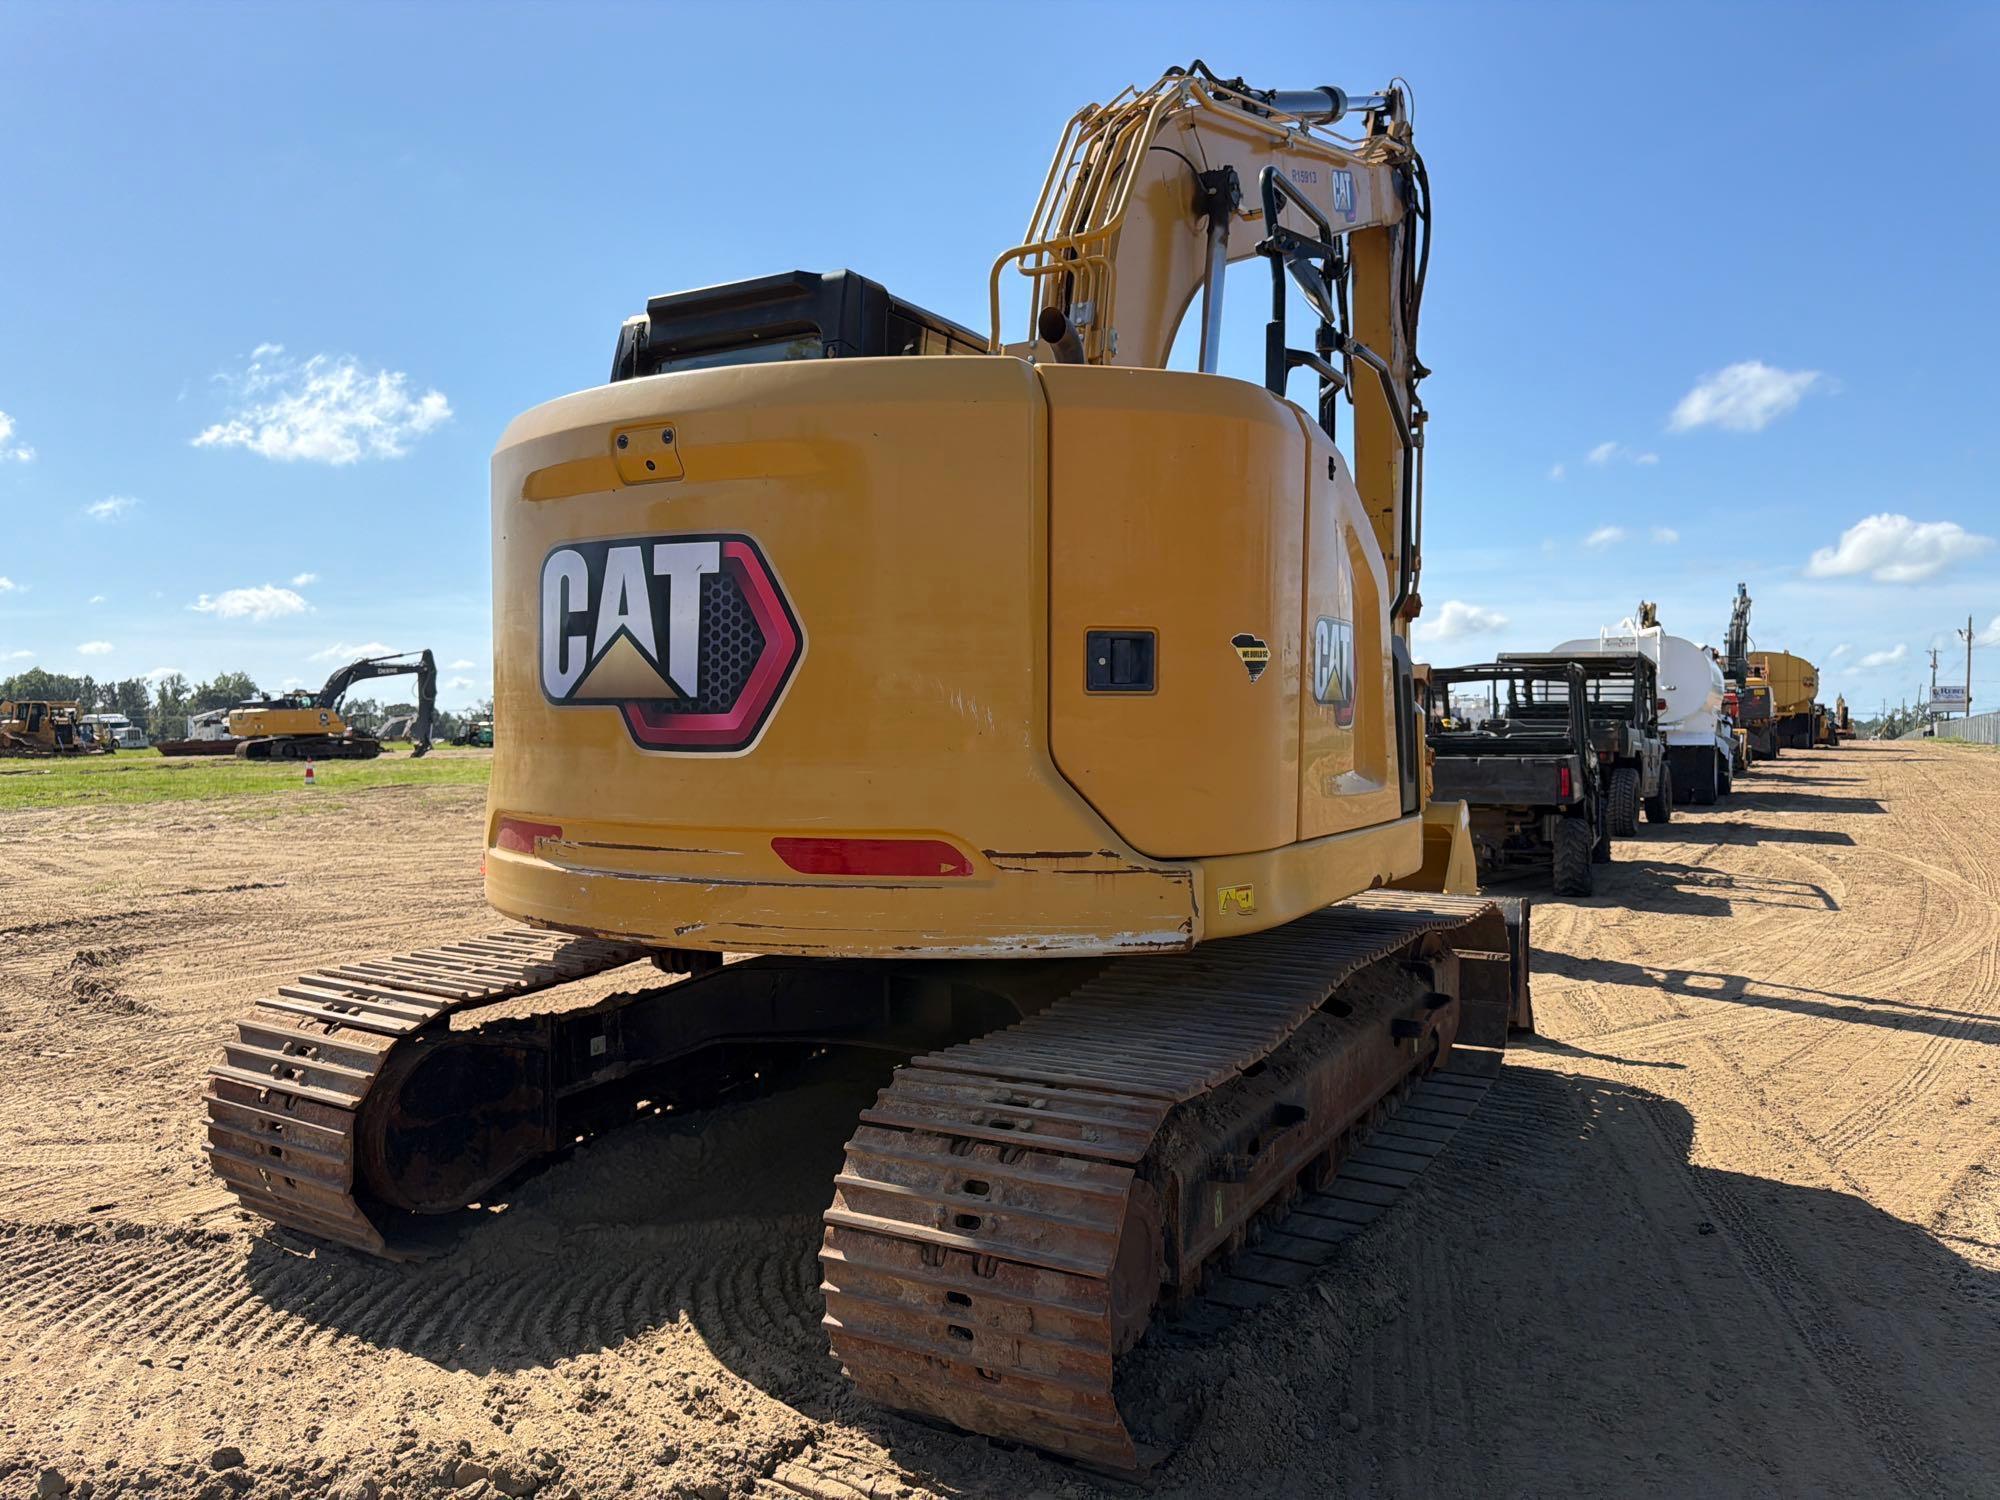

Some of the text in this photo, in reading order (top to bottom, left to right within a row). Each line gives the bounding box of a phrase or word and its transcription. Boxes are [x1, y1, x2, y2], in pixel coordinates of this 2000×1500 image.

[1333, 171, 1351, 210] CAT
[542, 541, 720, 698] CAT
[1315, 620, 1350, 701] CAT
